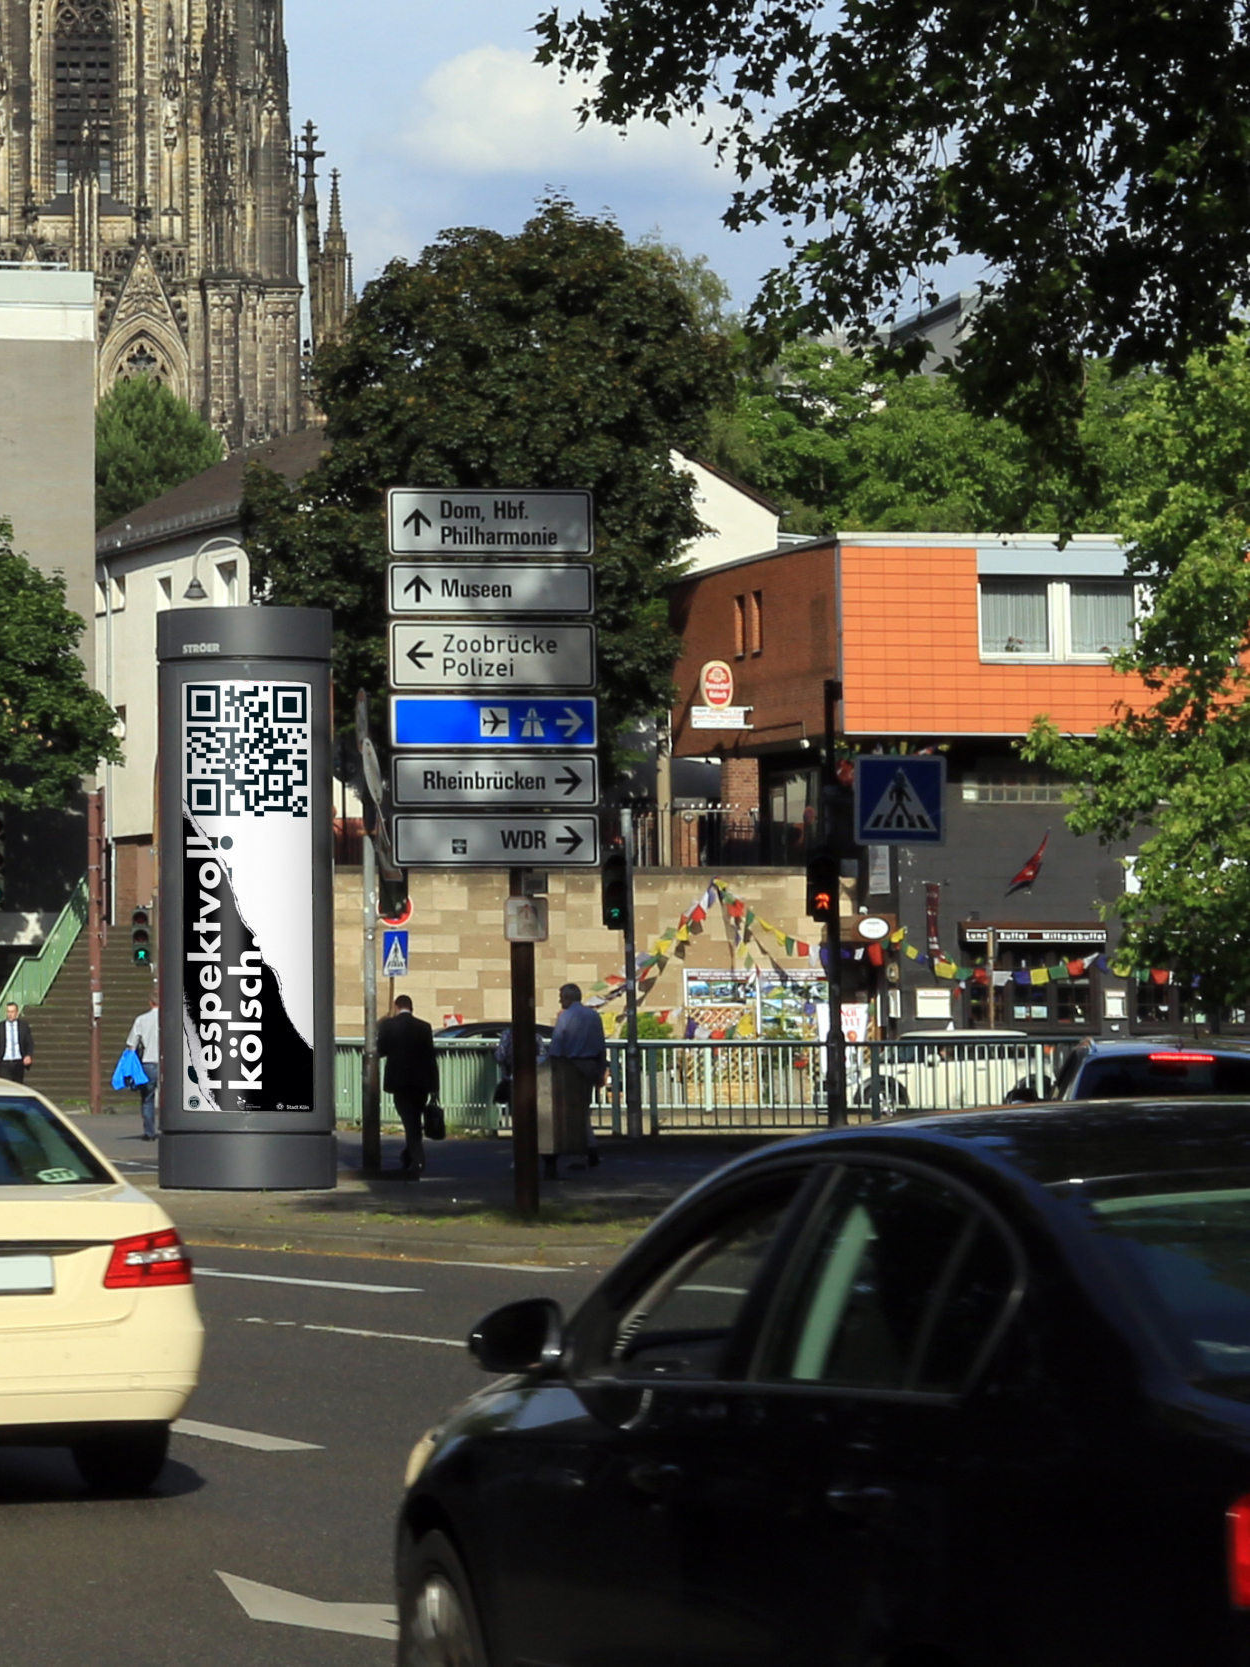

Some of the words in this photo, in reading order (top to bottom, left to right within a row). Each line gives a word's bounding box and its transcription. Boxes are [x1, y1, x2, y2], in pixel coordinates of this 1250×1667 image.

[440, 500, 485, 523] Dom,
[494, 500, 529, 520] Hbf.
[440, 525, 558, 547] Philharmonie
[441, 578, 512, 598] Museen
[182, 642, 220, 654] STRÖER
[443, 634, 558, 654] Zoobrücke
[443, 657, 514, 677] Polizei
[422, 770, 546, 791] Rheinbrücken
[500, 829, 547, 850] WDR
[965, 932, 988, 940] Lunc
[227, 937, 263, 1090] kölsch.
